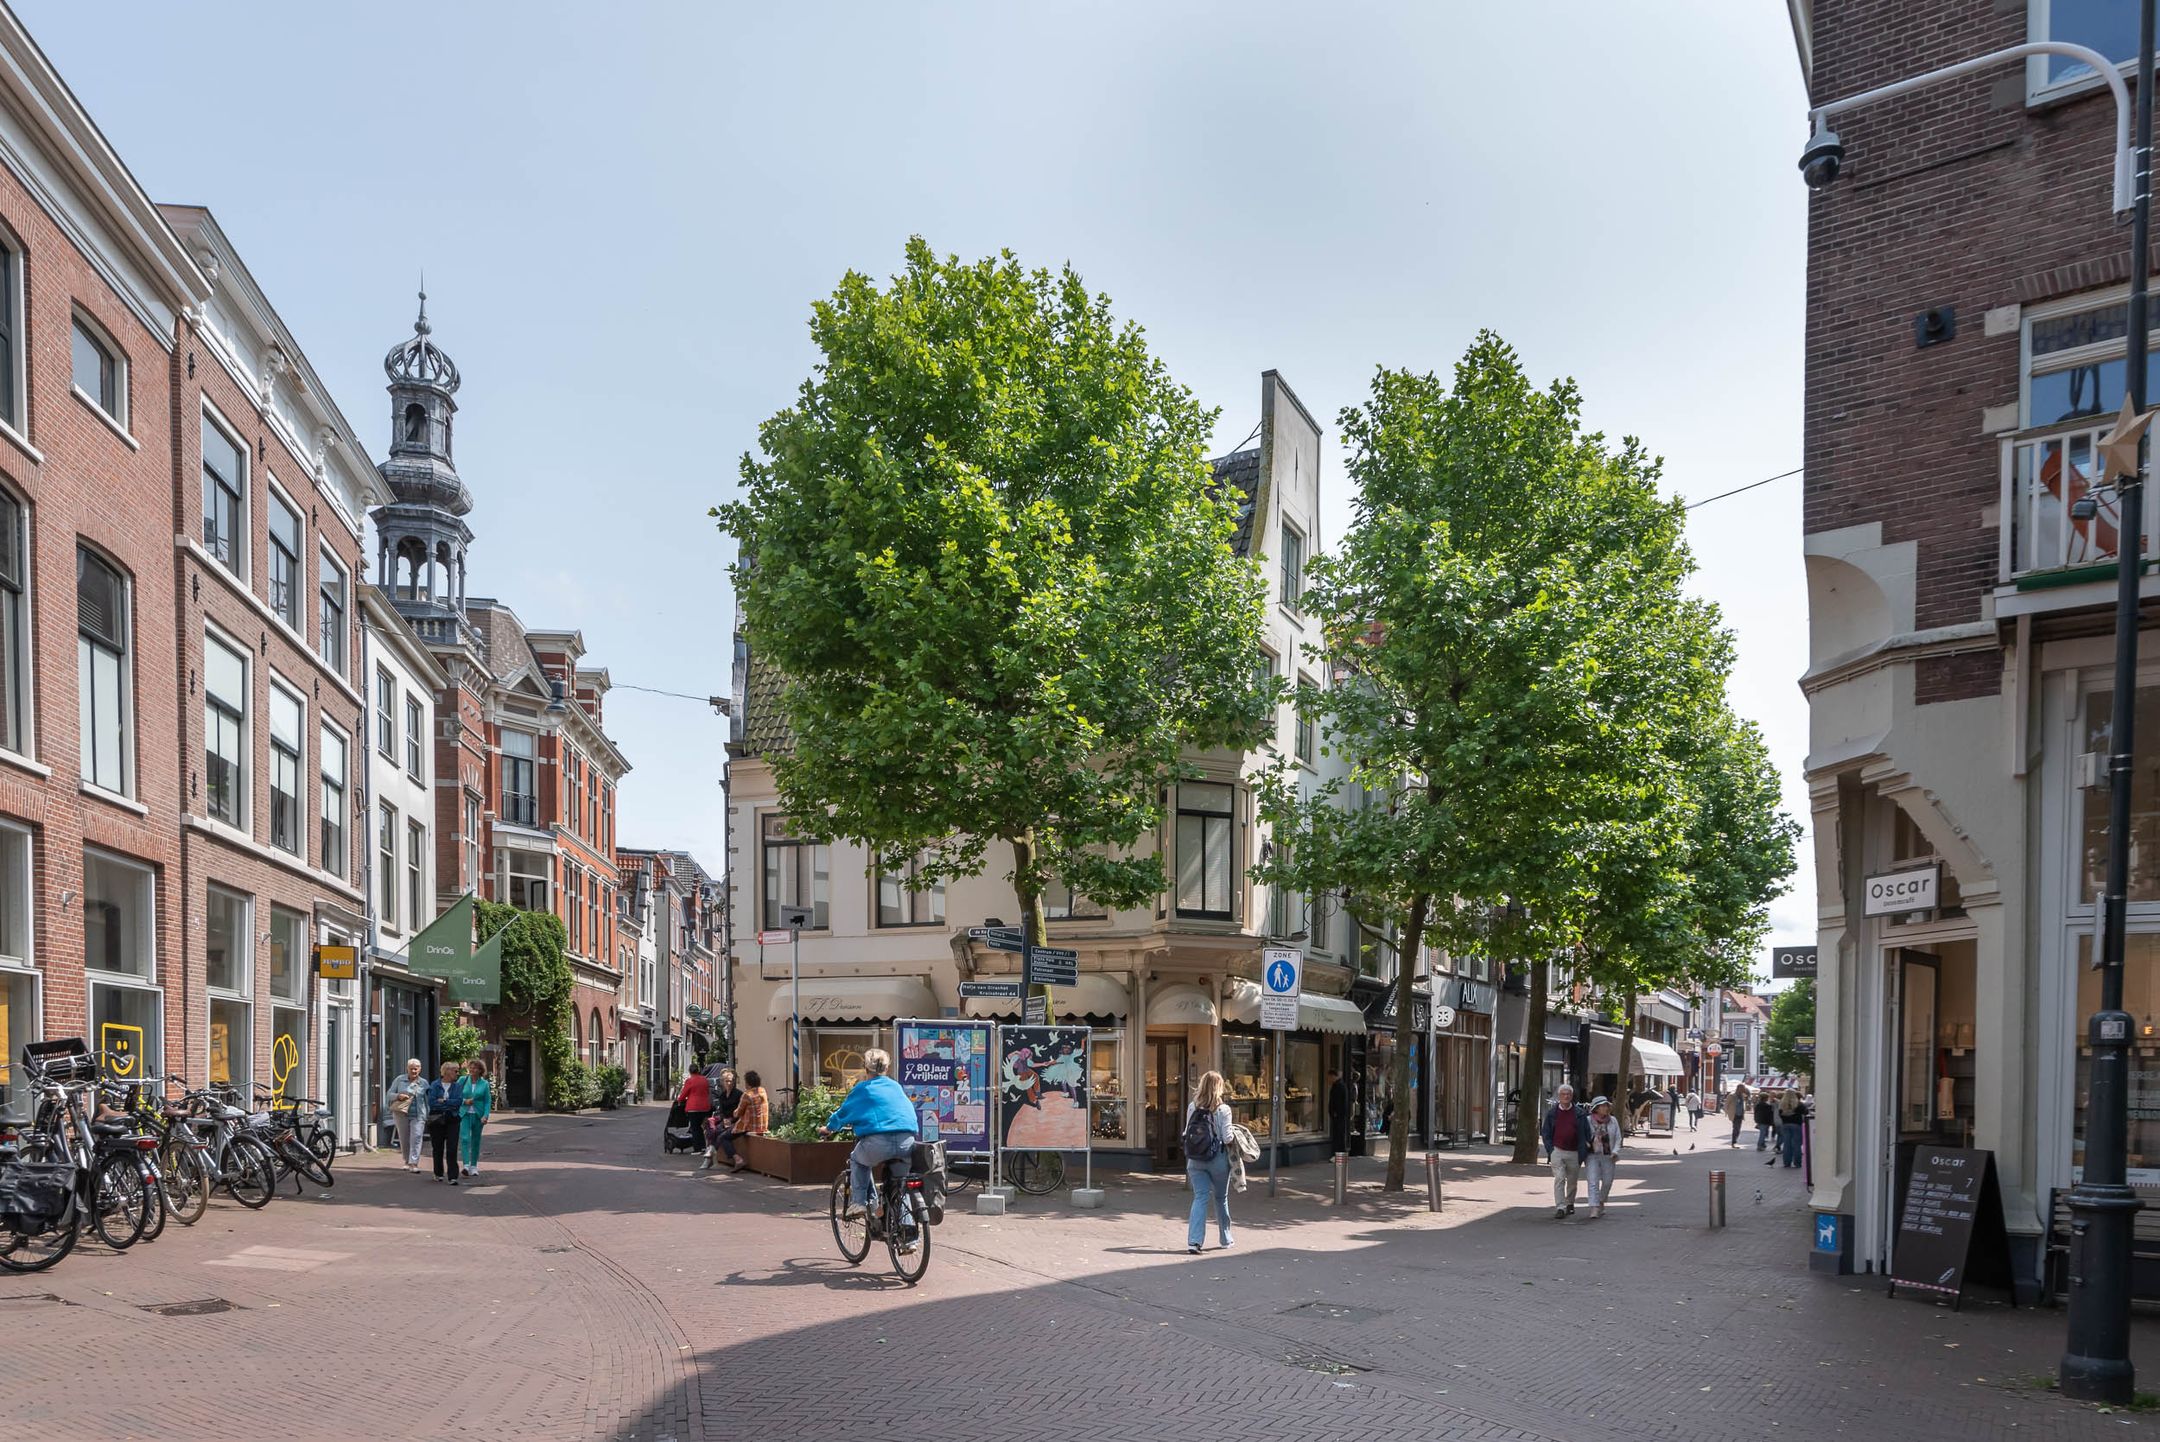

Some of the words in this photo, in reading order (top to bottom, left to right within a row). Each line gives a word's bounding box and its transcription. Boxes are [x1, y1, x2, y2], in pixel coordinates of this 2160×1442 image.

[1871, 878, 1930, 899] Oscar
[917, 1064, 930, 1072] 80
[931, 1064, 951, 1073] jaar
[912, 1072, 948, 1081] vrijheid
[1931, 1156, 1965, 1167] Oscar
